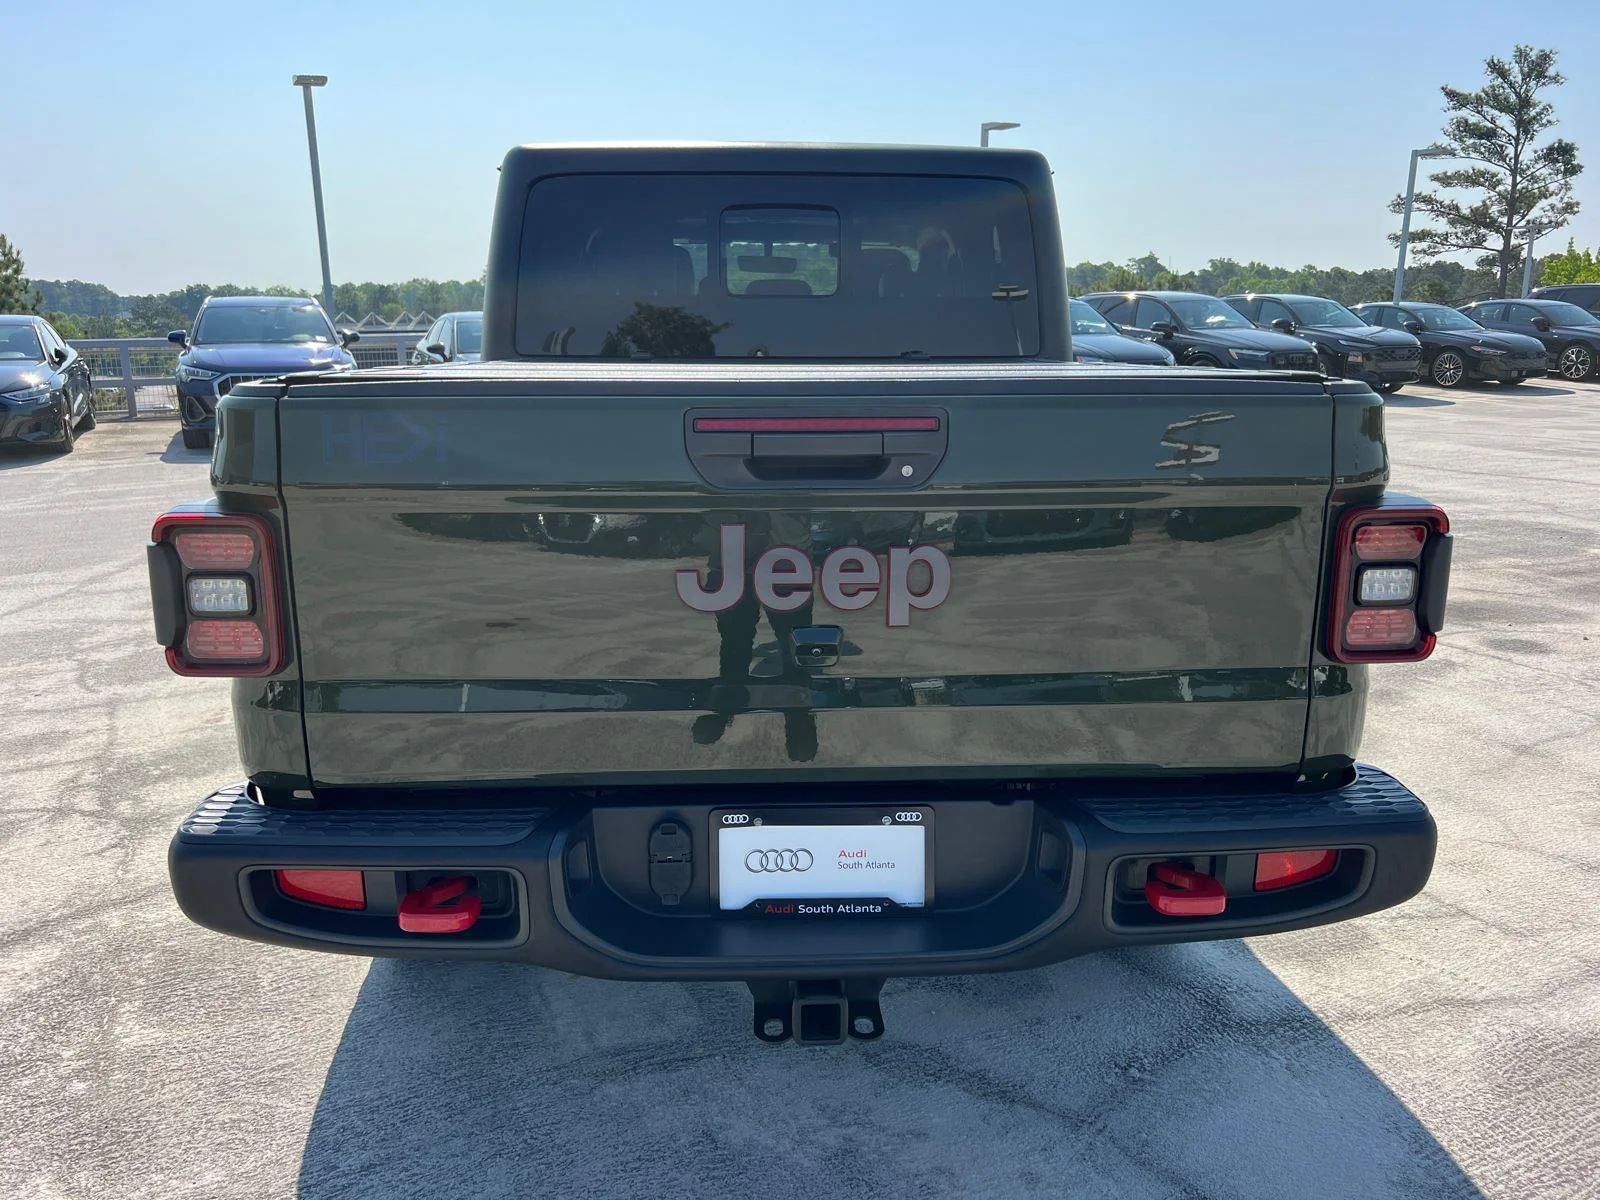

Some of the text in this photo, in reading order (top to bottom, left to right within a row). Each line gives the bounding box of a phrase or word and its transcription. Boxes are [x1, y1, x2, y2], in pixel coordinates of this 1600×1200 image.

[675, 522, 951, 627] Jeep
[838, 849, 867, 858] Audi
[837, 860, 896, 870] South Atlanta
[764, 904, 882, 914] Audi South Atlanta
